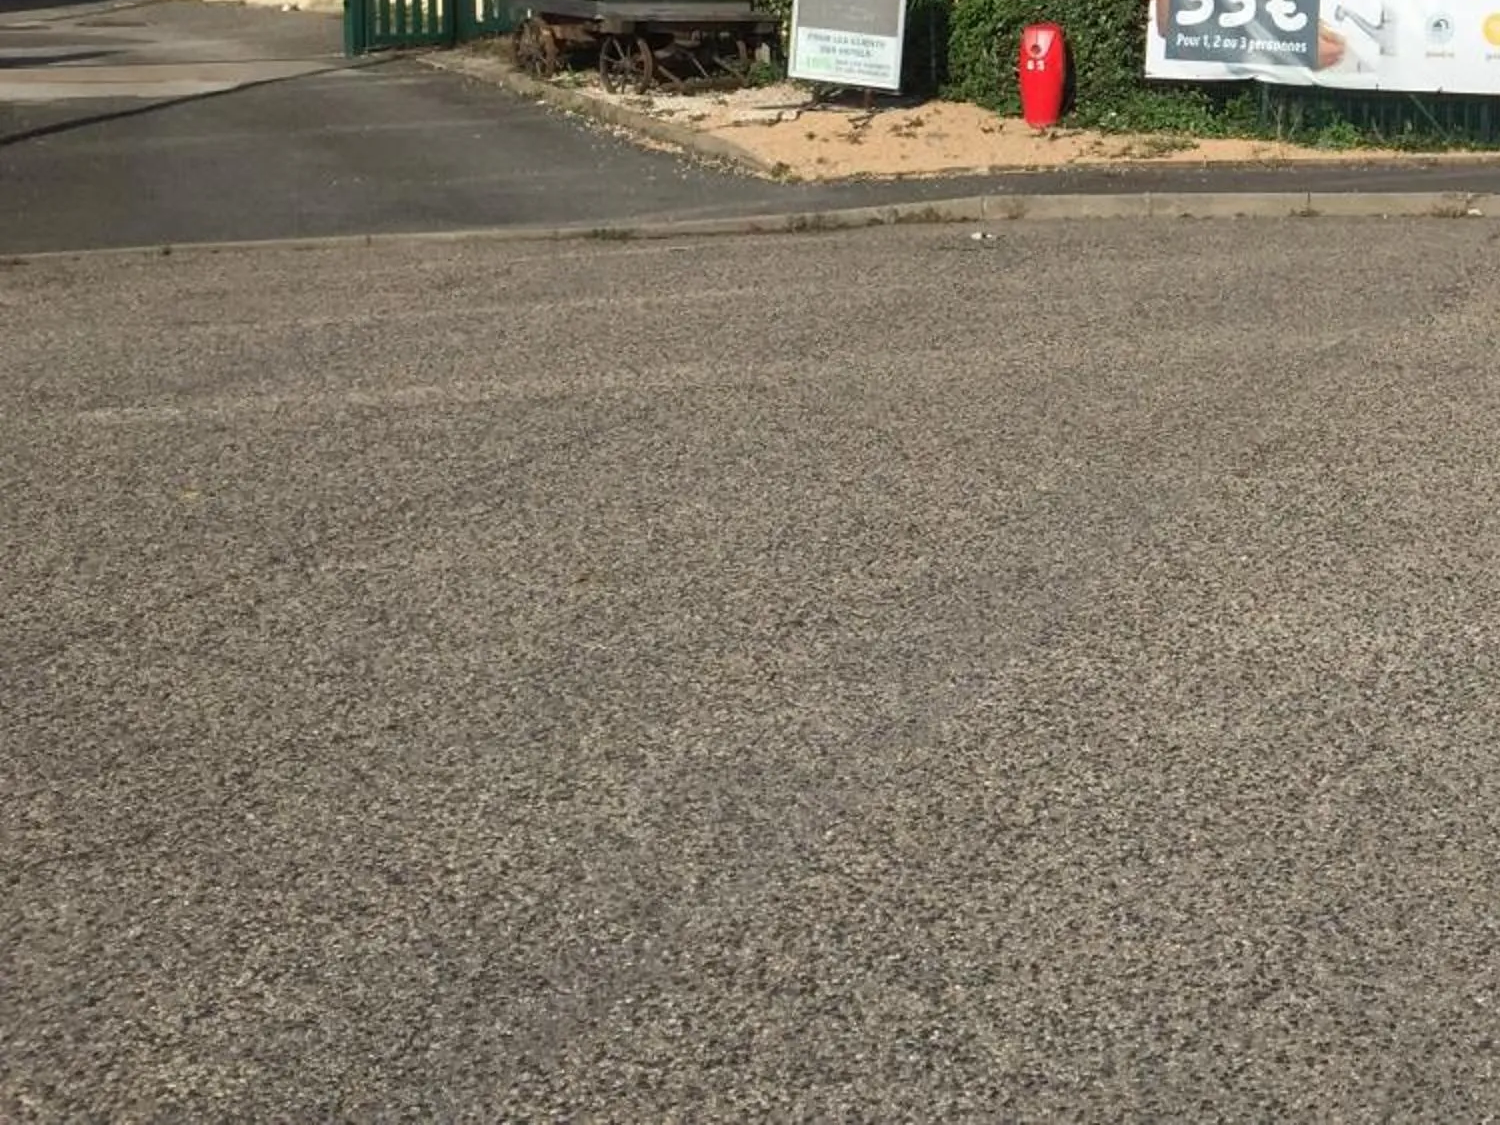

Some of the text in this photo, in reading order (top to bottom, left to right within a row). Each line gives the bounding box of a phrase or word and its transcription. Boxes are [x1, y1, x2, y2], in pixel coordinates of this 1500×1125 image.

[1176, 34, 1201, 48] Pour
[1223, 38, 1238, 49] ou
[1249, 39, 1308, 54] personnes
